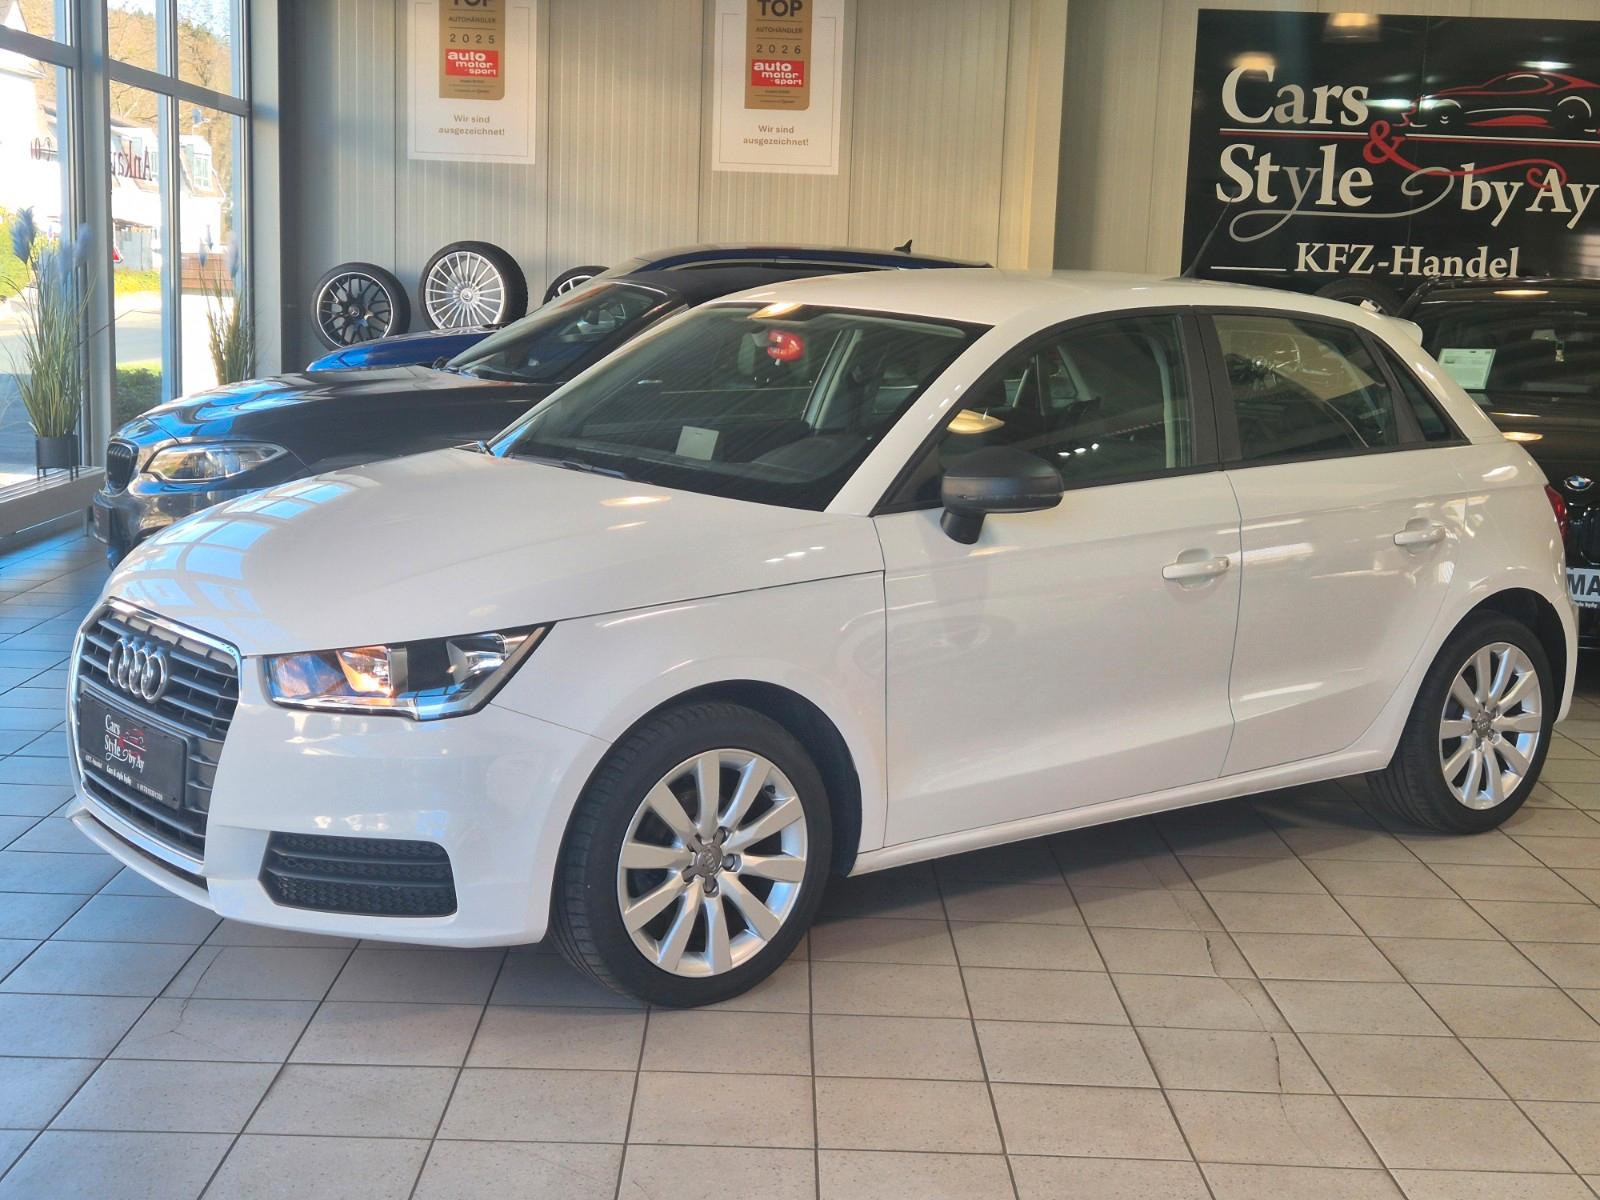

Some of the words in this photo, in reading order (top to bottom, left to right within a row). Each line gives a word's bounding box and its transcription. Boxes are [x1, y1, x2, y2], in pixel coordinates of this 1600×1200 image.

[758, 0, 803, 17] TOP
[449, 33, 495, 45] 2025
[756, 44, 801, 55] 2026
[448, 51, 486, 62] auto
[455, 61, 493, 69] motor
[753, 61, 792, 72] auto
[469, 68, 496, 76] sport
[761, 71, 799, 80] motor
[774, 78, 802, 86] sport
[1222, 65, 1369, 127] Cars
[453, 115, 468, 123] Wir
[471, 115, 490, 124] sind
[438, 127, 505, 136] ausgezeichnet!
[758, 124, 773, 134] Wir
[776, 125, 794, 135] sind
[743, 136, 809, 147] ausgezeichnet!
[1215, 143, 1374, 242] Style
[1460, 162, 1524, 228] by
[1295, 242, 1519, 278] KFZ-Handel
[105, 714, 120, 736] Cars
[105, 734, 121, 760] Style
